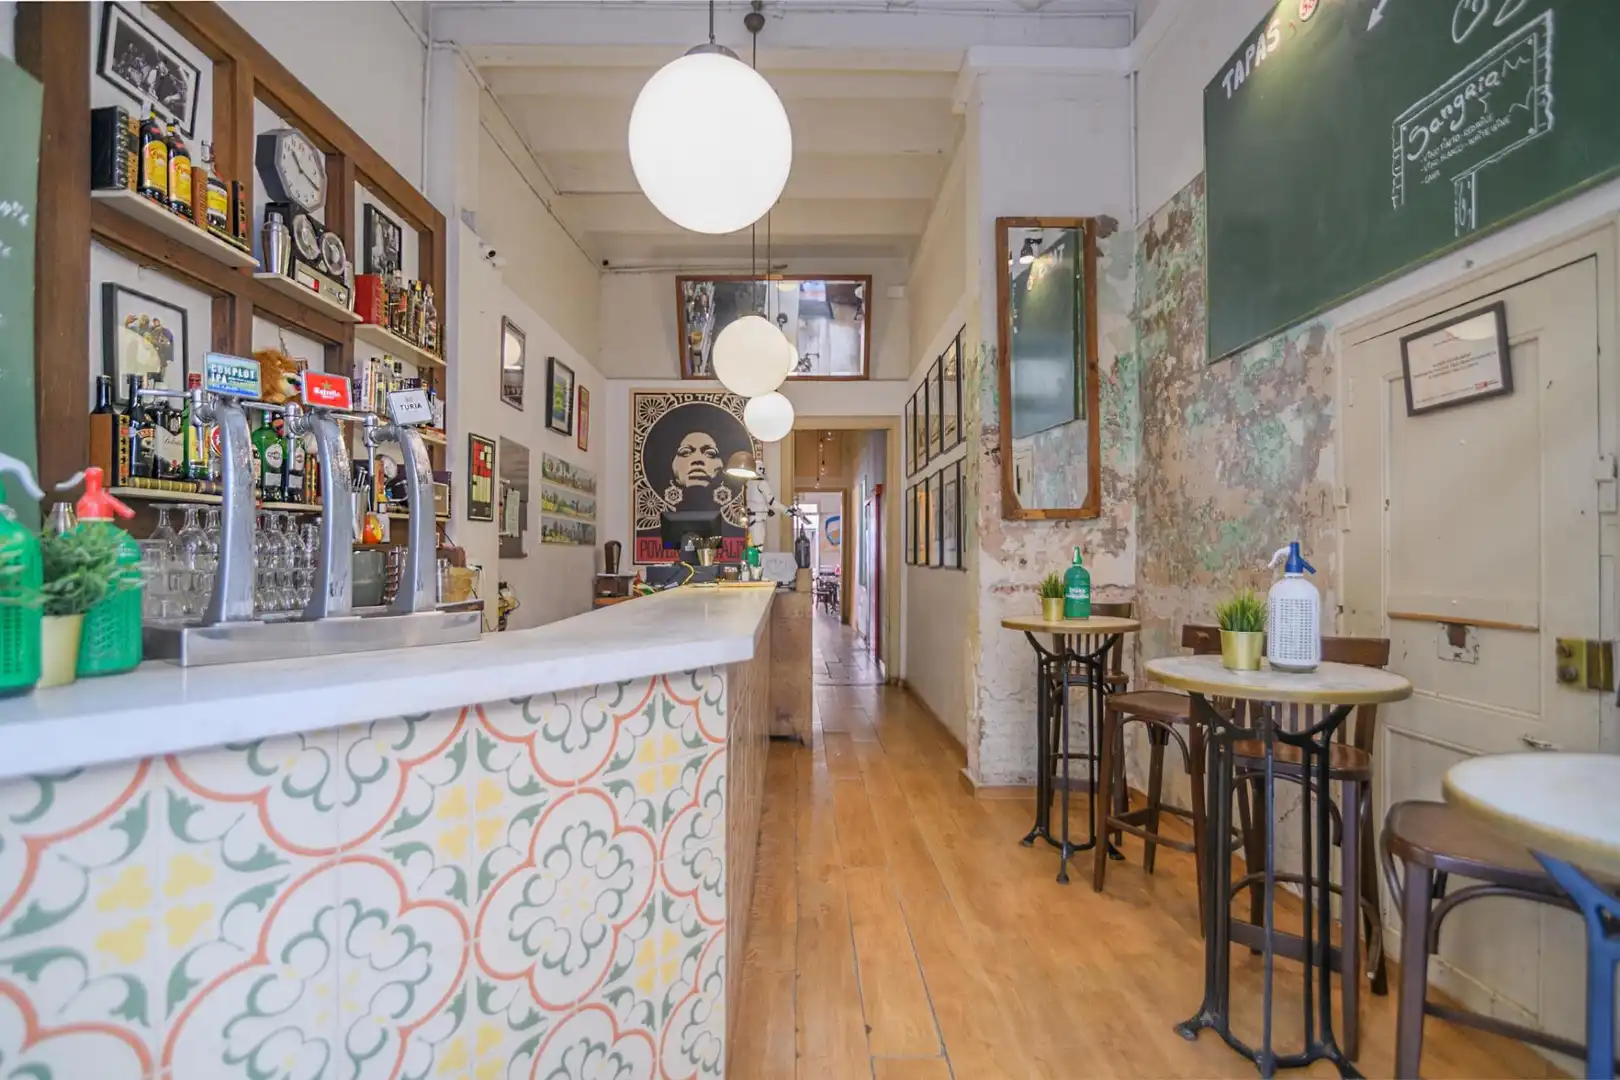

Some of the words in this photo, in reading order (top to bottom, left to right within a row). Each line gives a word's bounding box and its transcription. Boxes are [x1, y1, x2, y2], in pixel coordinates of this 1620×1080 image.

[1221, 18, 1281, 99] TAPAS
[211, 363, 256, 380] COMPLOT
[211, 373, 227, 384] IPA
[675, 393, 694, 403] TO
[695, 393, 722, 404] THE
[400, 403, 423, 411] TURIA
[633, 434, 645, 481] POWER
